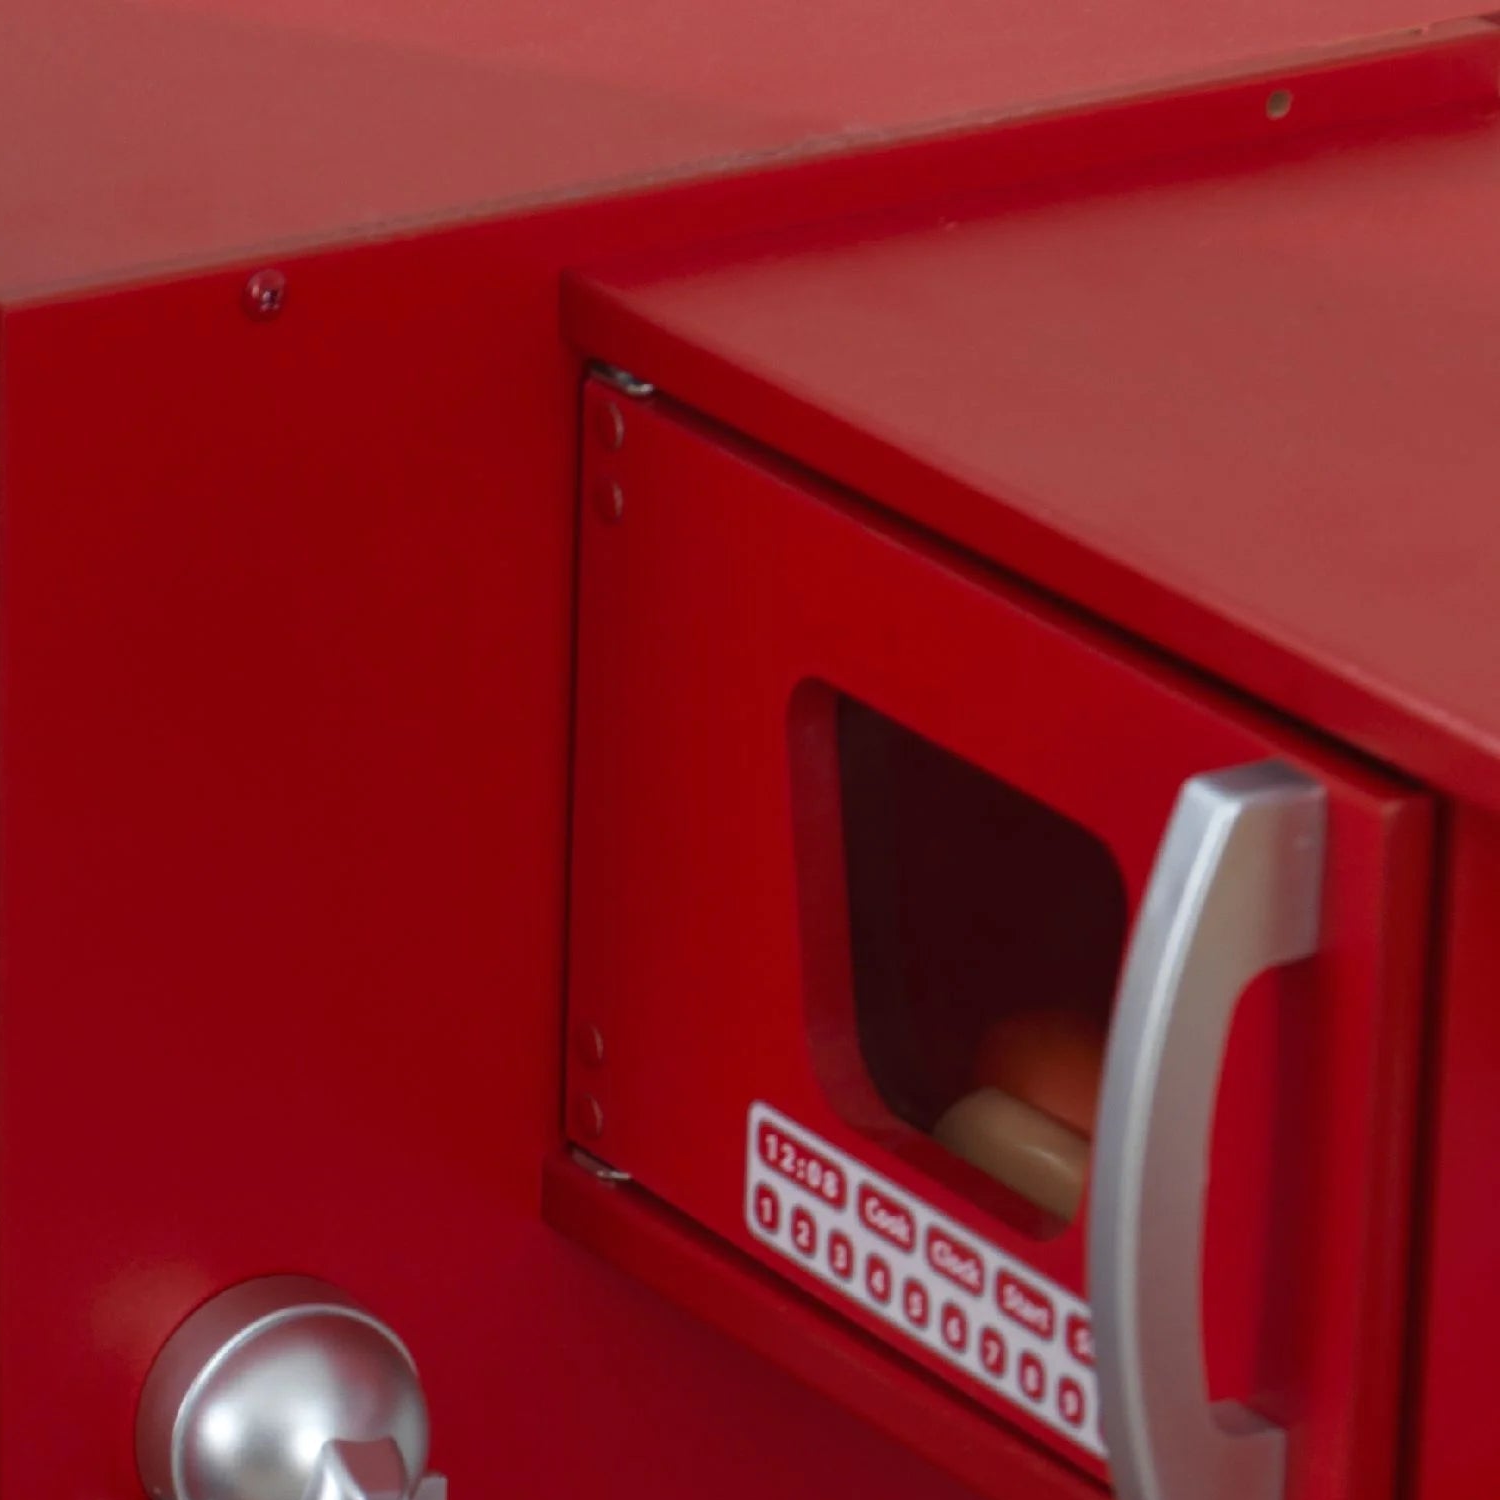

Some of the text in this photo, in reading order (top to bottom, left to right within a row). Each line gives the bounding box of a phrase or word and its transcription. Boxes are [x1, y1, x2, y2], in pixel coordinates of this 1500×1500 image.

[760, 1195, 773, 1223] 1
[795, 1219, 809, 1248] 2
[984, 1339, 999, 1366] 7
